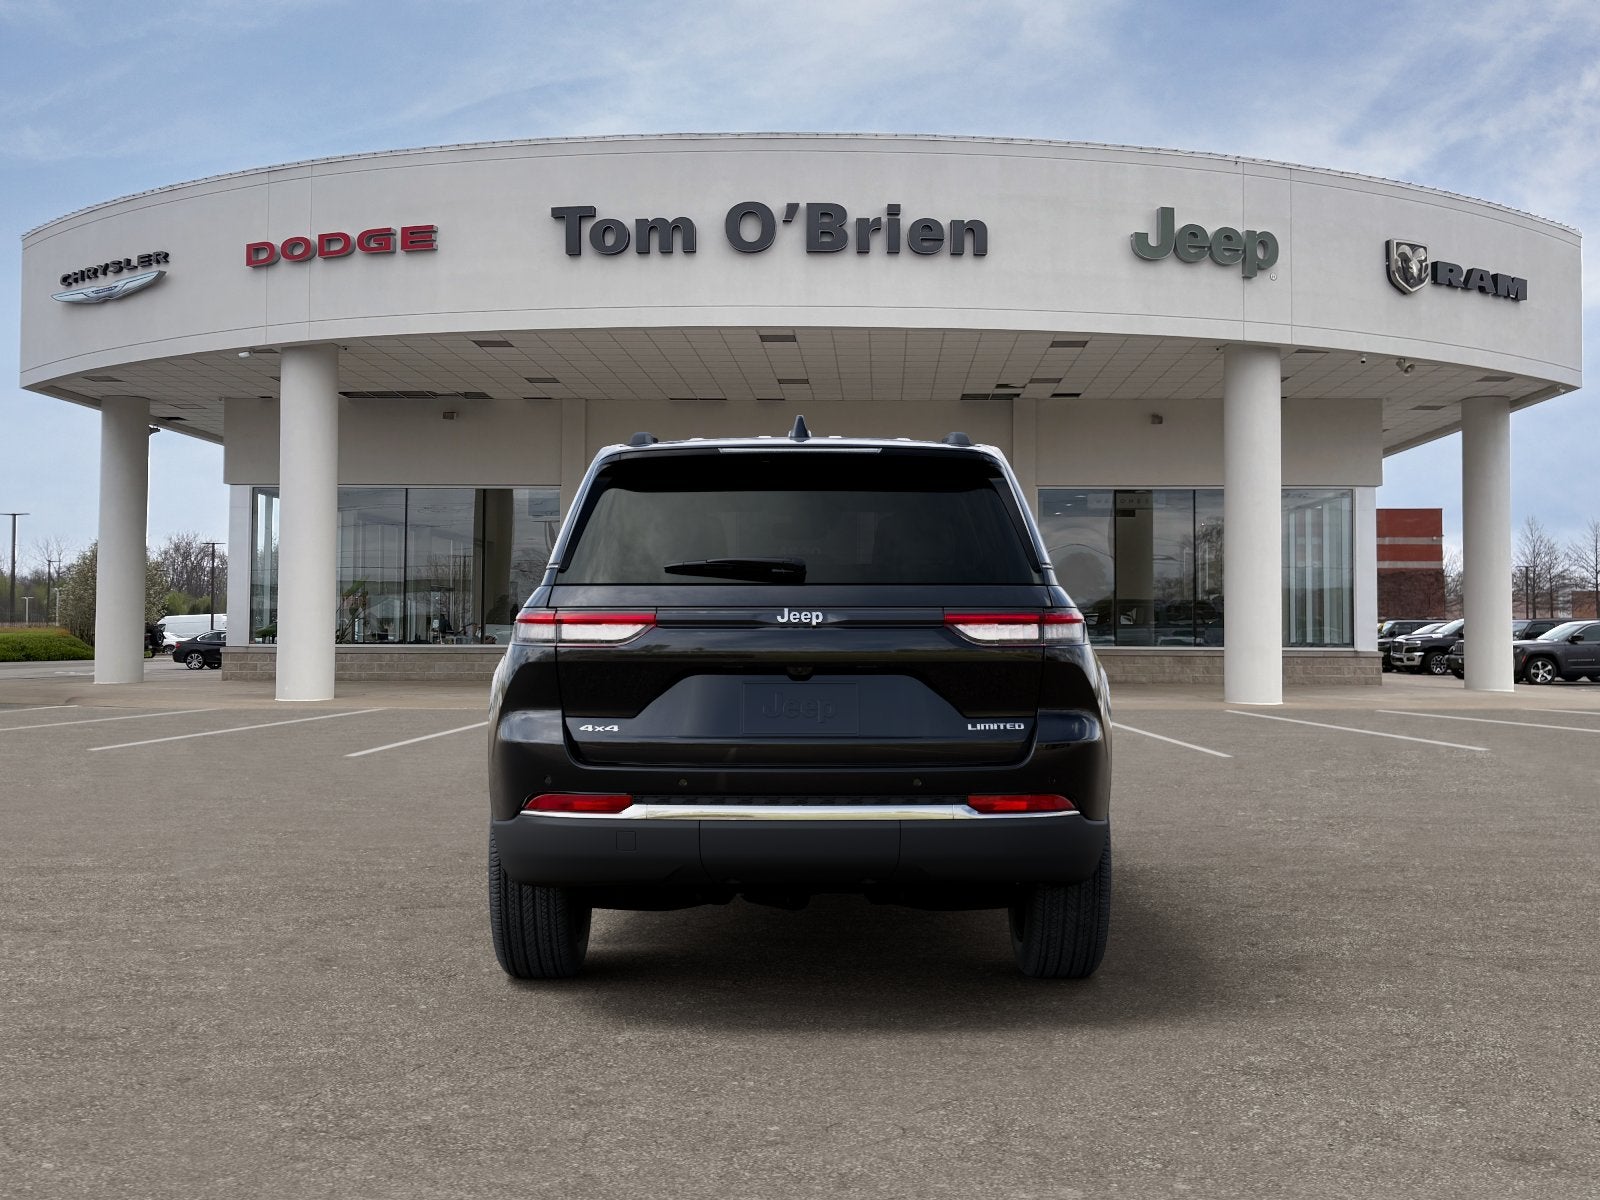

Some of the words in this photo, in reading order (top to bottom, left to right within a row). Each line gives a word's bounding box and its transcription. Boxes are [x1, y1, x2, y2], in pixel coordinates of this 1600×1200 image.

[246, 224, 438, 268] DODGE
[551, 205, 697, 256] Tom
[725, 201, 988, 256] O'Brien
[1130, 207, 1279, 278] Jeep
[60, 250, 170, 287] CHRYSLER
[1431, 261, 1528, 301] RAM
[776, 607, 823, 626] Jeep
[762, 691, 837, 724] Jeep
[967, 722, 1025, 731] LIMITED
